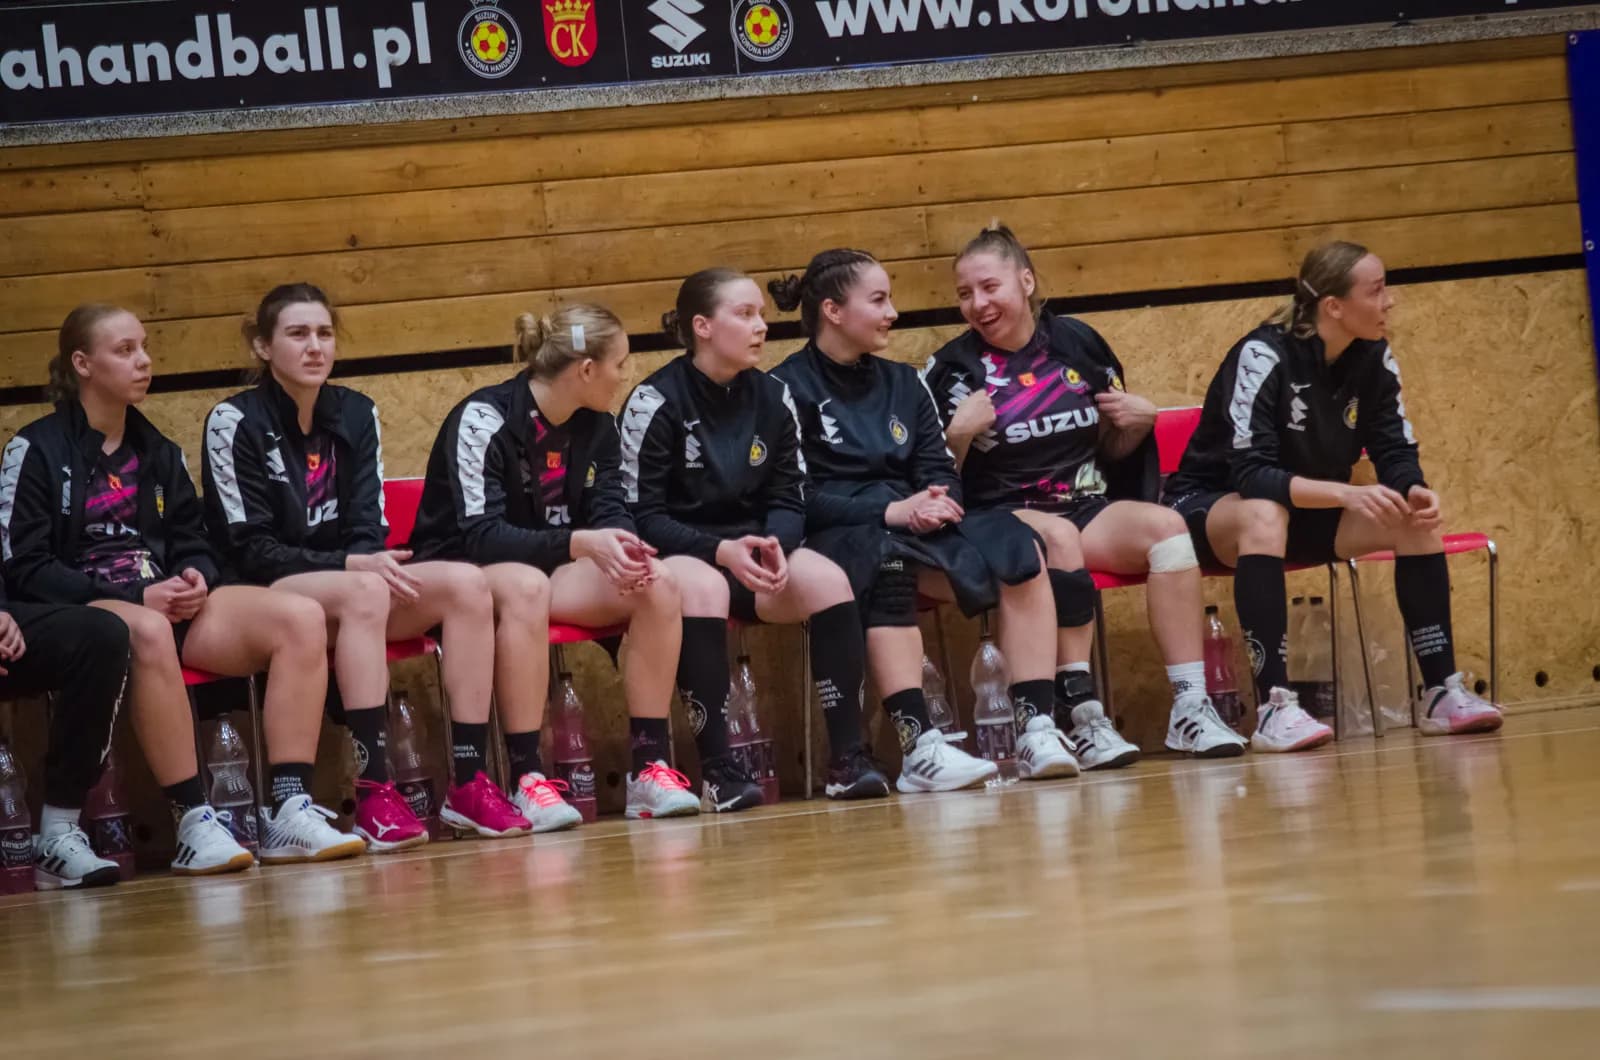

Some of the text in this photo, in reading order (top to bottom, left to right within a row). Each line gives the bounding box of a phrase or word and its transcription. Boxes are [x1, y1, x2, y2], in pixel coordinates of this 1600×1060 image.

[474, 12, 499, 22] SUZUKI
[0, 2, 431, 90] ahandball.pl
[551, 23, 589, 58] CK
[651, 53, 711, 68] SUZUKI
